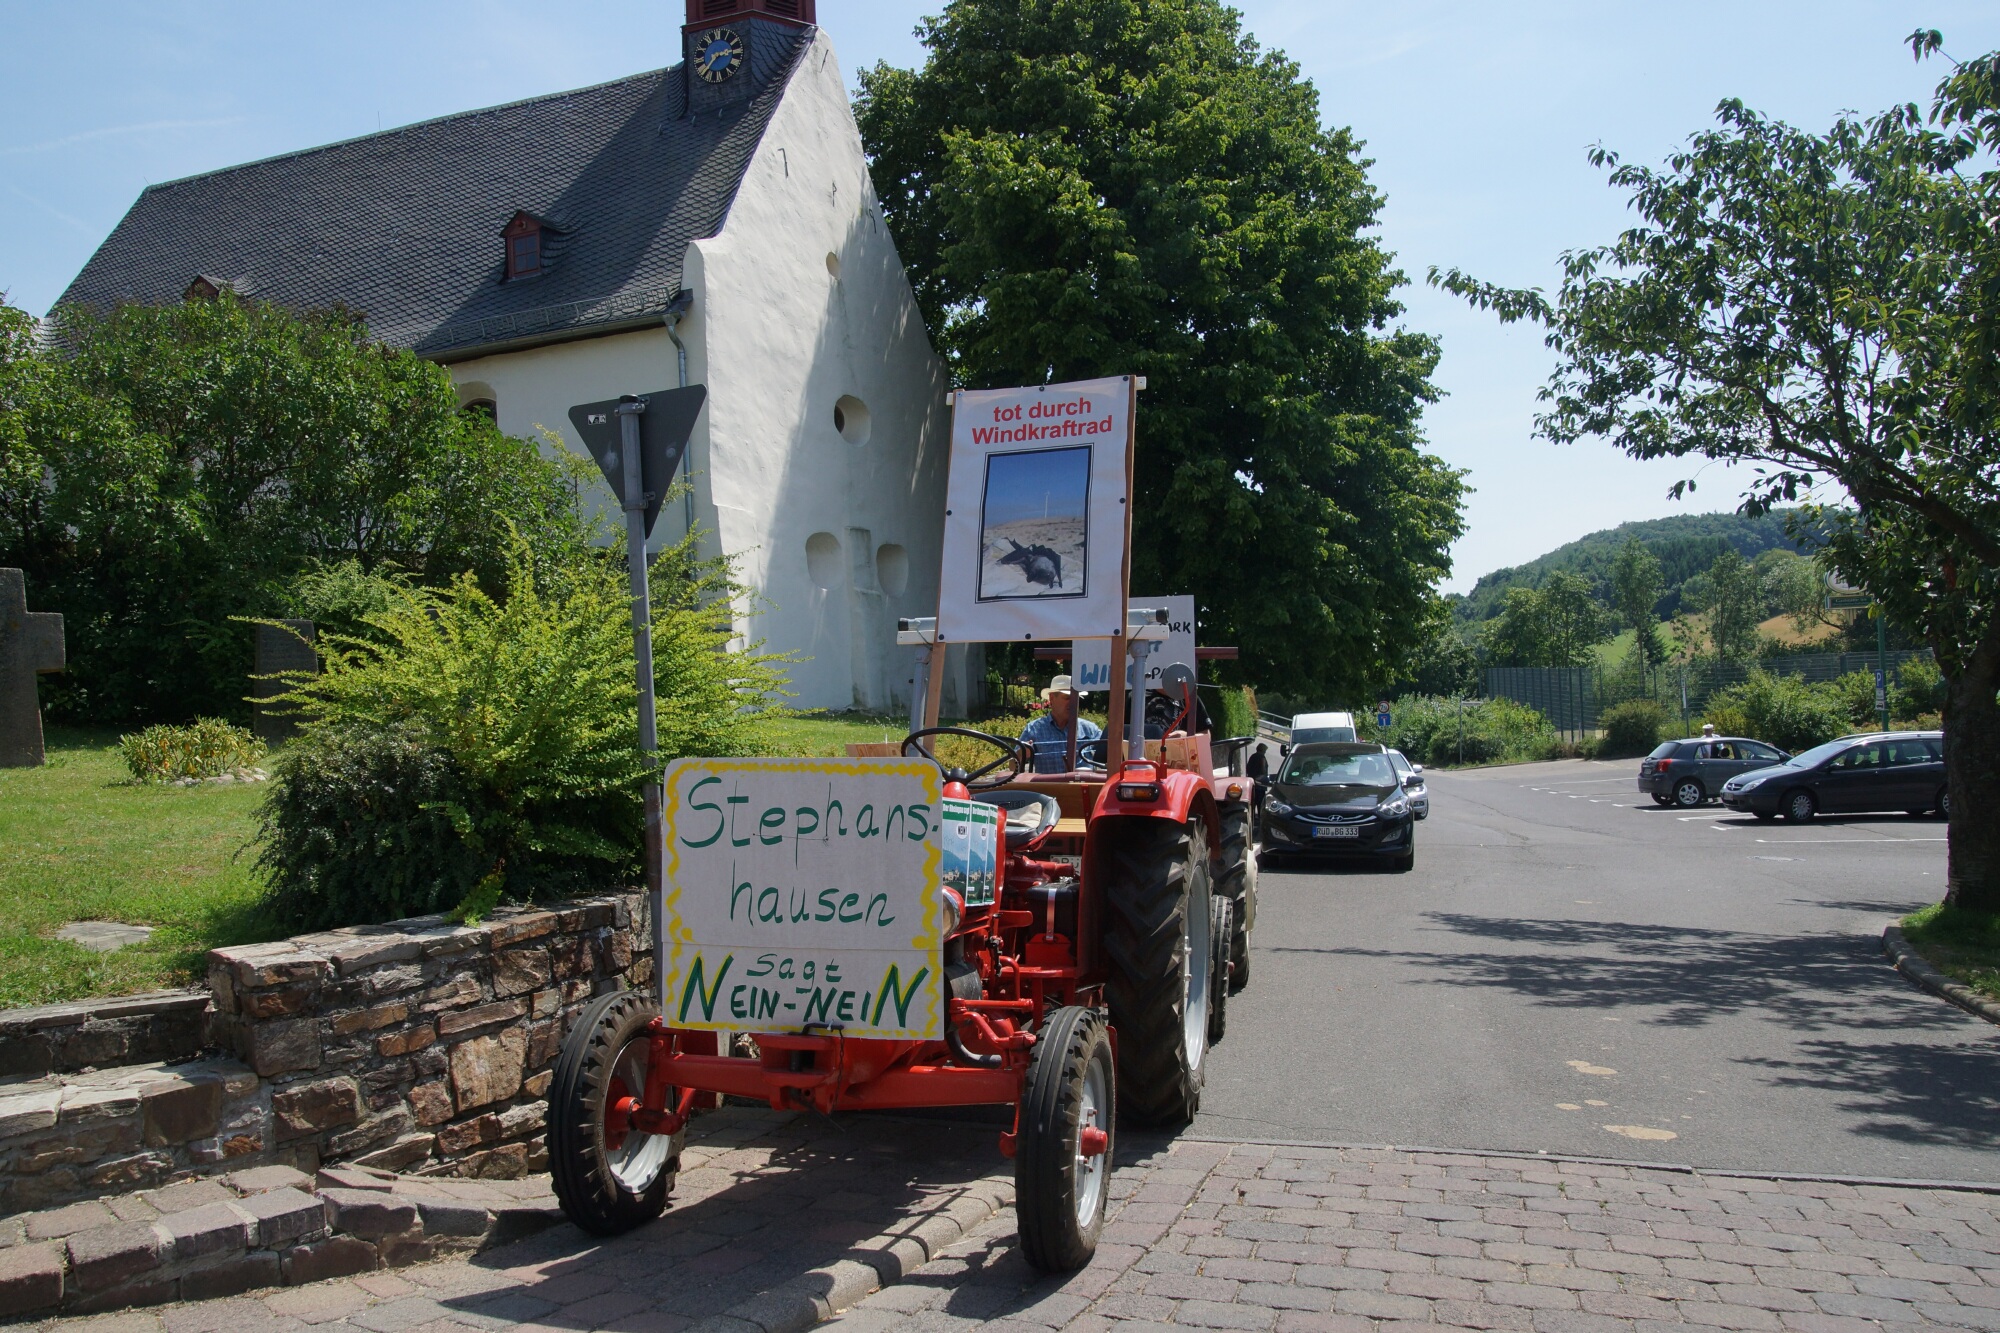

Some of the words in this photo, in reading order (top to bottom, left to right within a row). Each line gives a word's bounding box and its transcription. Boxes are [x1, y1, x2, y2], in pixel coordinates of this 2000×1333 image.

[993, 404, 1022, 423] tot
[1028, 397, 1092, 419] durch
[972, 414, 1113, 445] Windkraftrad
[1345, 827, 1358, 836] 333
[730, 858, 896, 927] hausen
